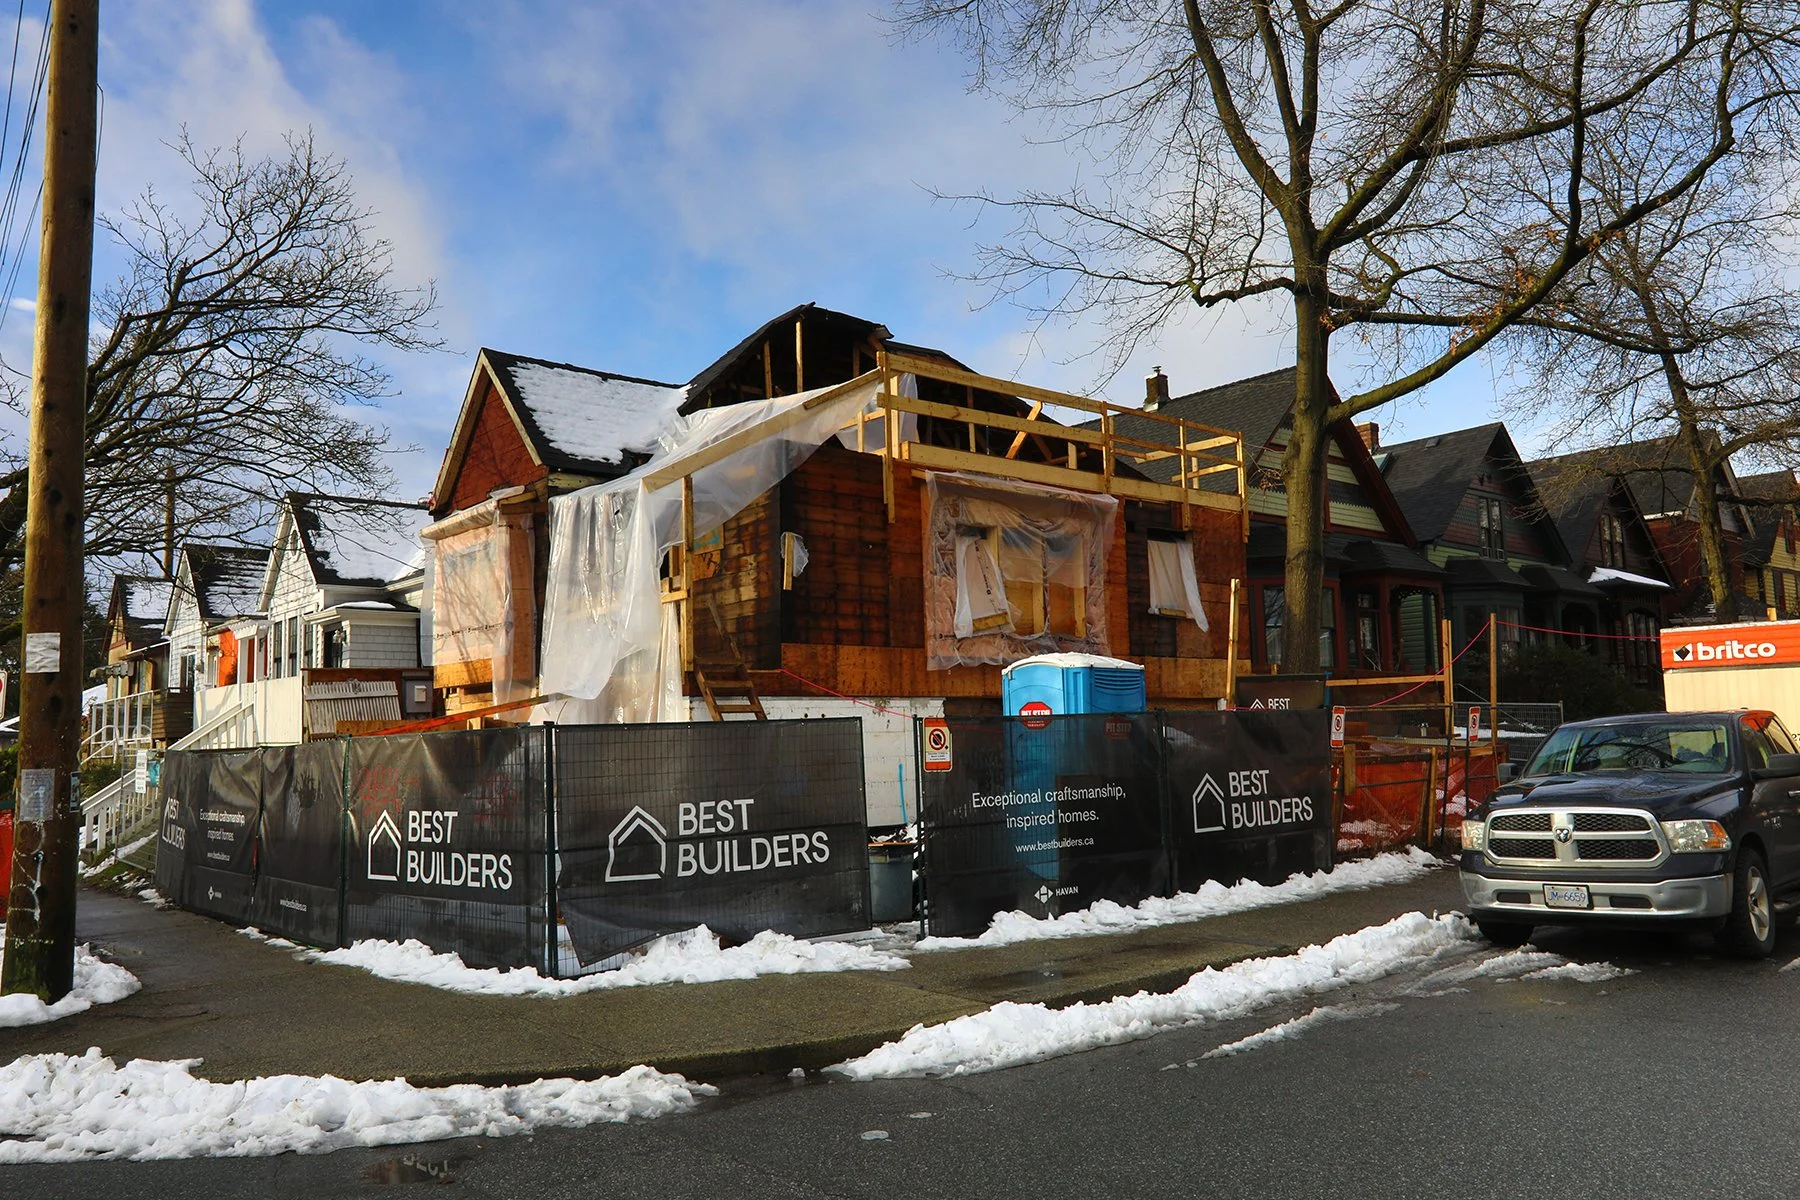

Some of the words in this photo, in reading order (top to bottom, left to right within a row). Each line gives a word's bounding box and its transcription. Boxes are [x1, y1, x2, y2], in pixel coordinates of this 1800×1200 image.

[1697, 640, 1776, 660] britco
[1268, 698, 1290, 710] BEST
[972, 788, 1041, 810] Exceptional
[1045, 783, 1126, 803] craftsmanship,
[1228, 769, 1270, 797] BEST
[679, 798, 754, 836] BEST
[1006, 810, 1055, 831] inspired
[1058, 809, 1099, 824] homes.
[1231, 796, 1314, 829] BUILDERS
[408, 810, 459, 844] BEST
[677, 830, 830, 878] BUILDERS
[1016, 837, 1094, 853] www.bestbuilders.ca
[406, 850, 513, 891] BUILDERS
[1055, 886, 1079, 897] HAVAN
